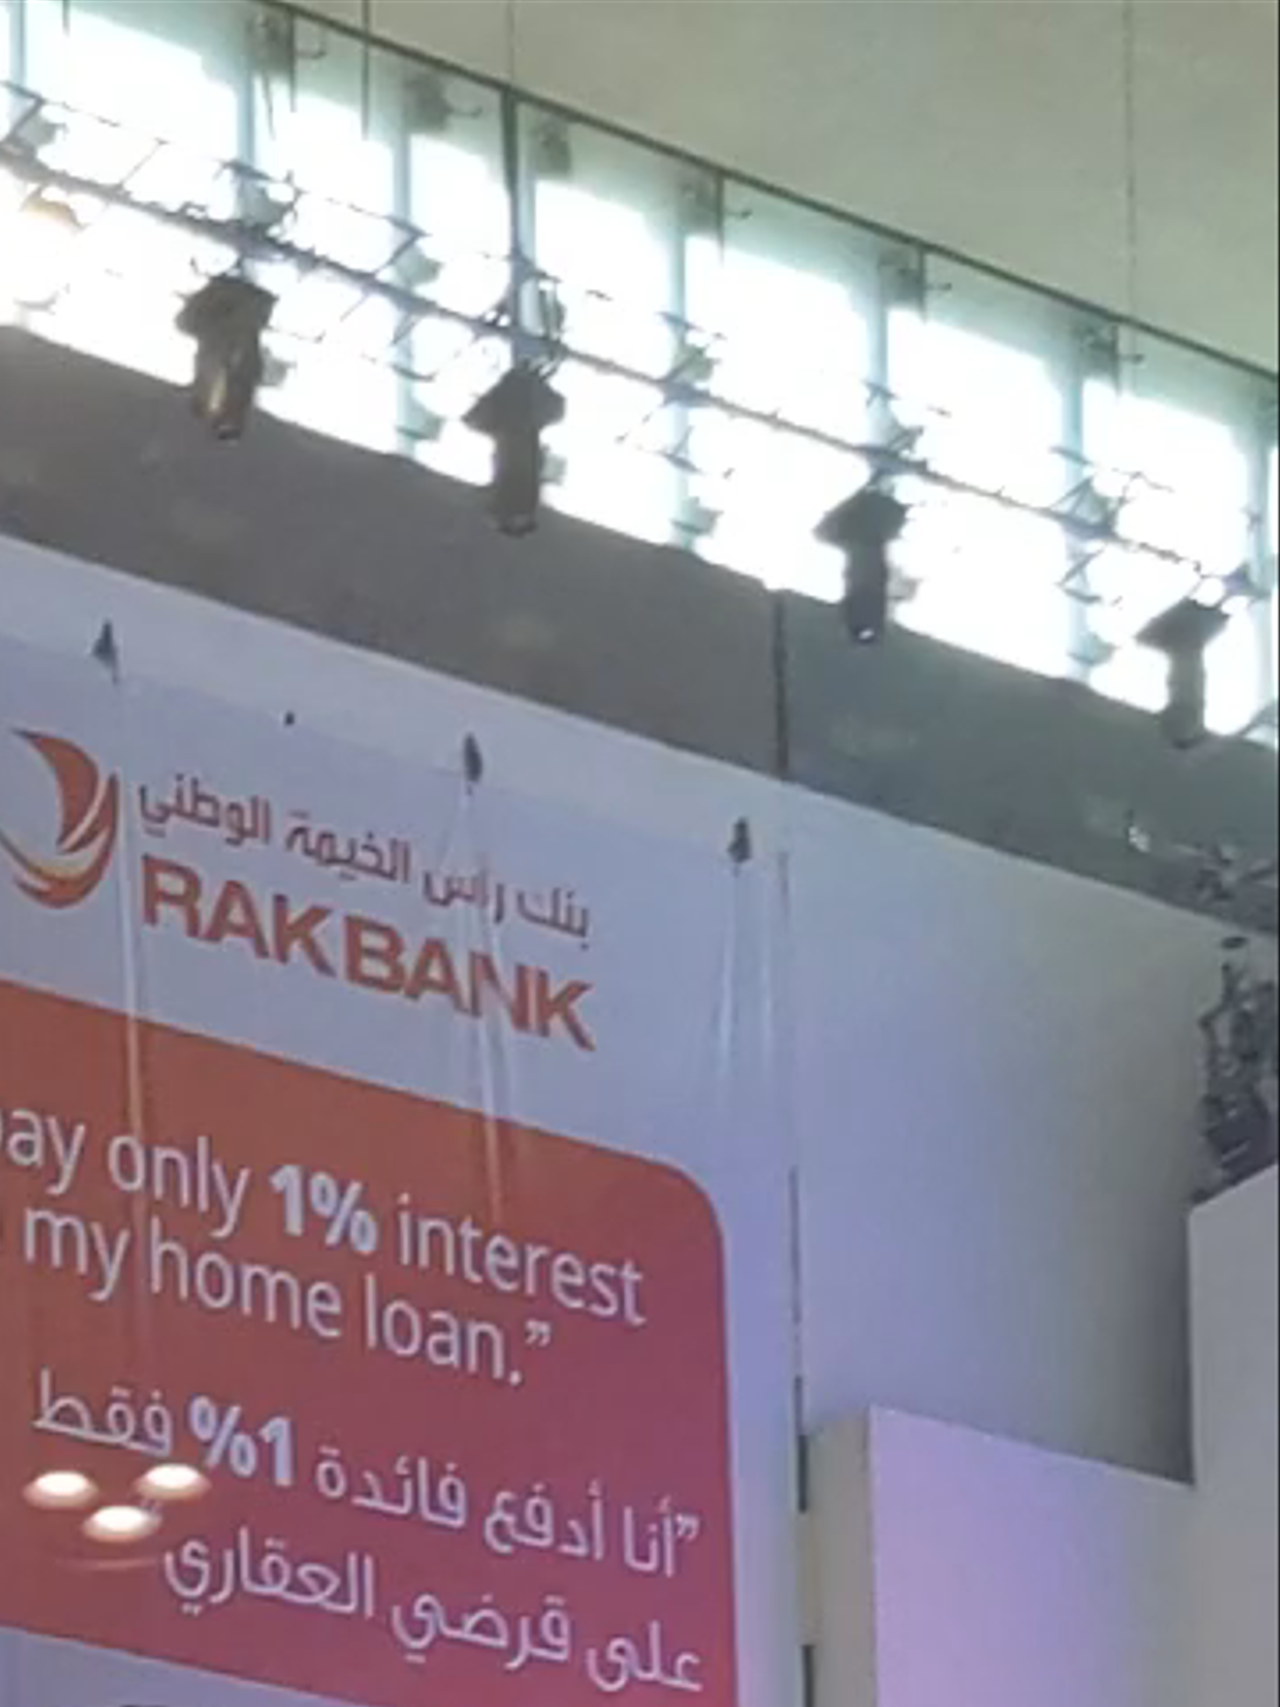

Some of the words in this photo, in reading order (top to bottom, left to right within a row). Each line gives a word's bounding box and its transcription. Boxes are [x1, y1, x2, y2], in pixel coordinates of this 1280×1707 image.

[139, 772, 272, 848] الوطني
[285, 808, 411, 882] الخيمة
[142, 853, 597, 1052] RAKBANK
[516, 876, 592, 950] بنك
[108, 1135, 251, 1240] only
[267, 1163, 378, 1254] 1%
[397, 1192, 647, 1326] interest
[23, 1207, 130, 1302] my
[148, 1216, 342, 1340] home
[32, 1366, 175, 1458] فقط
[315, 1446, 468, 1530] فائدة
[483, 1480, 606, 1561] أدفع
[392, 1592, 572, 1670] قرضي
[585, 1620, 704, 1693] على
